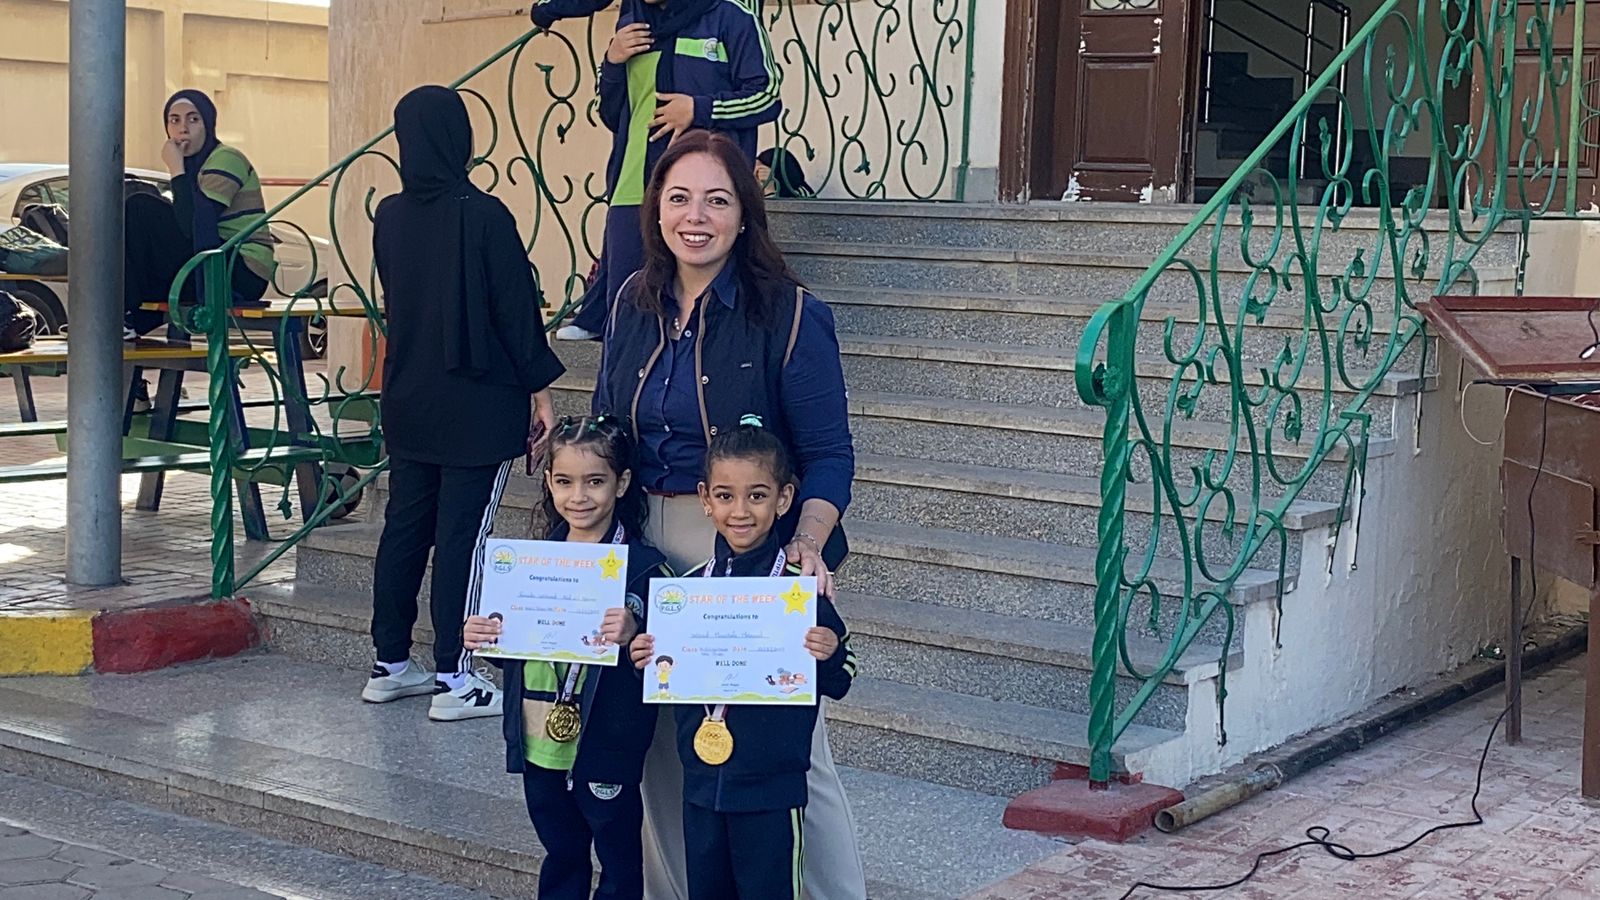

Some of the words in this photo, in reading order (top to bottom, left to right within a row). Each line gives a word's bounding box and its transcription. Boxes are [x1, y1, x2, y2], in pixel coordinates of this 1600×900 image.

[519, 555, 539, 565] STAR
[541, 557, 552, 567] OF
[555, 557, 571, 567] THE
[574, 559, 595, 568] WEEK
[529, 574, 572, 582] Congratulations
[688, 594, 713, 604] STAR
[716, 594, 728, 604] OF
[732, 594, 750, 604] THE
[752, 594, 776, 604] WEEK
[703, 613, 751, 621] Congratulations
